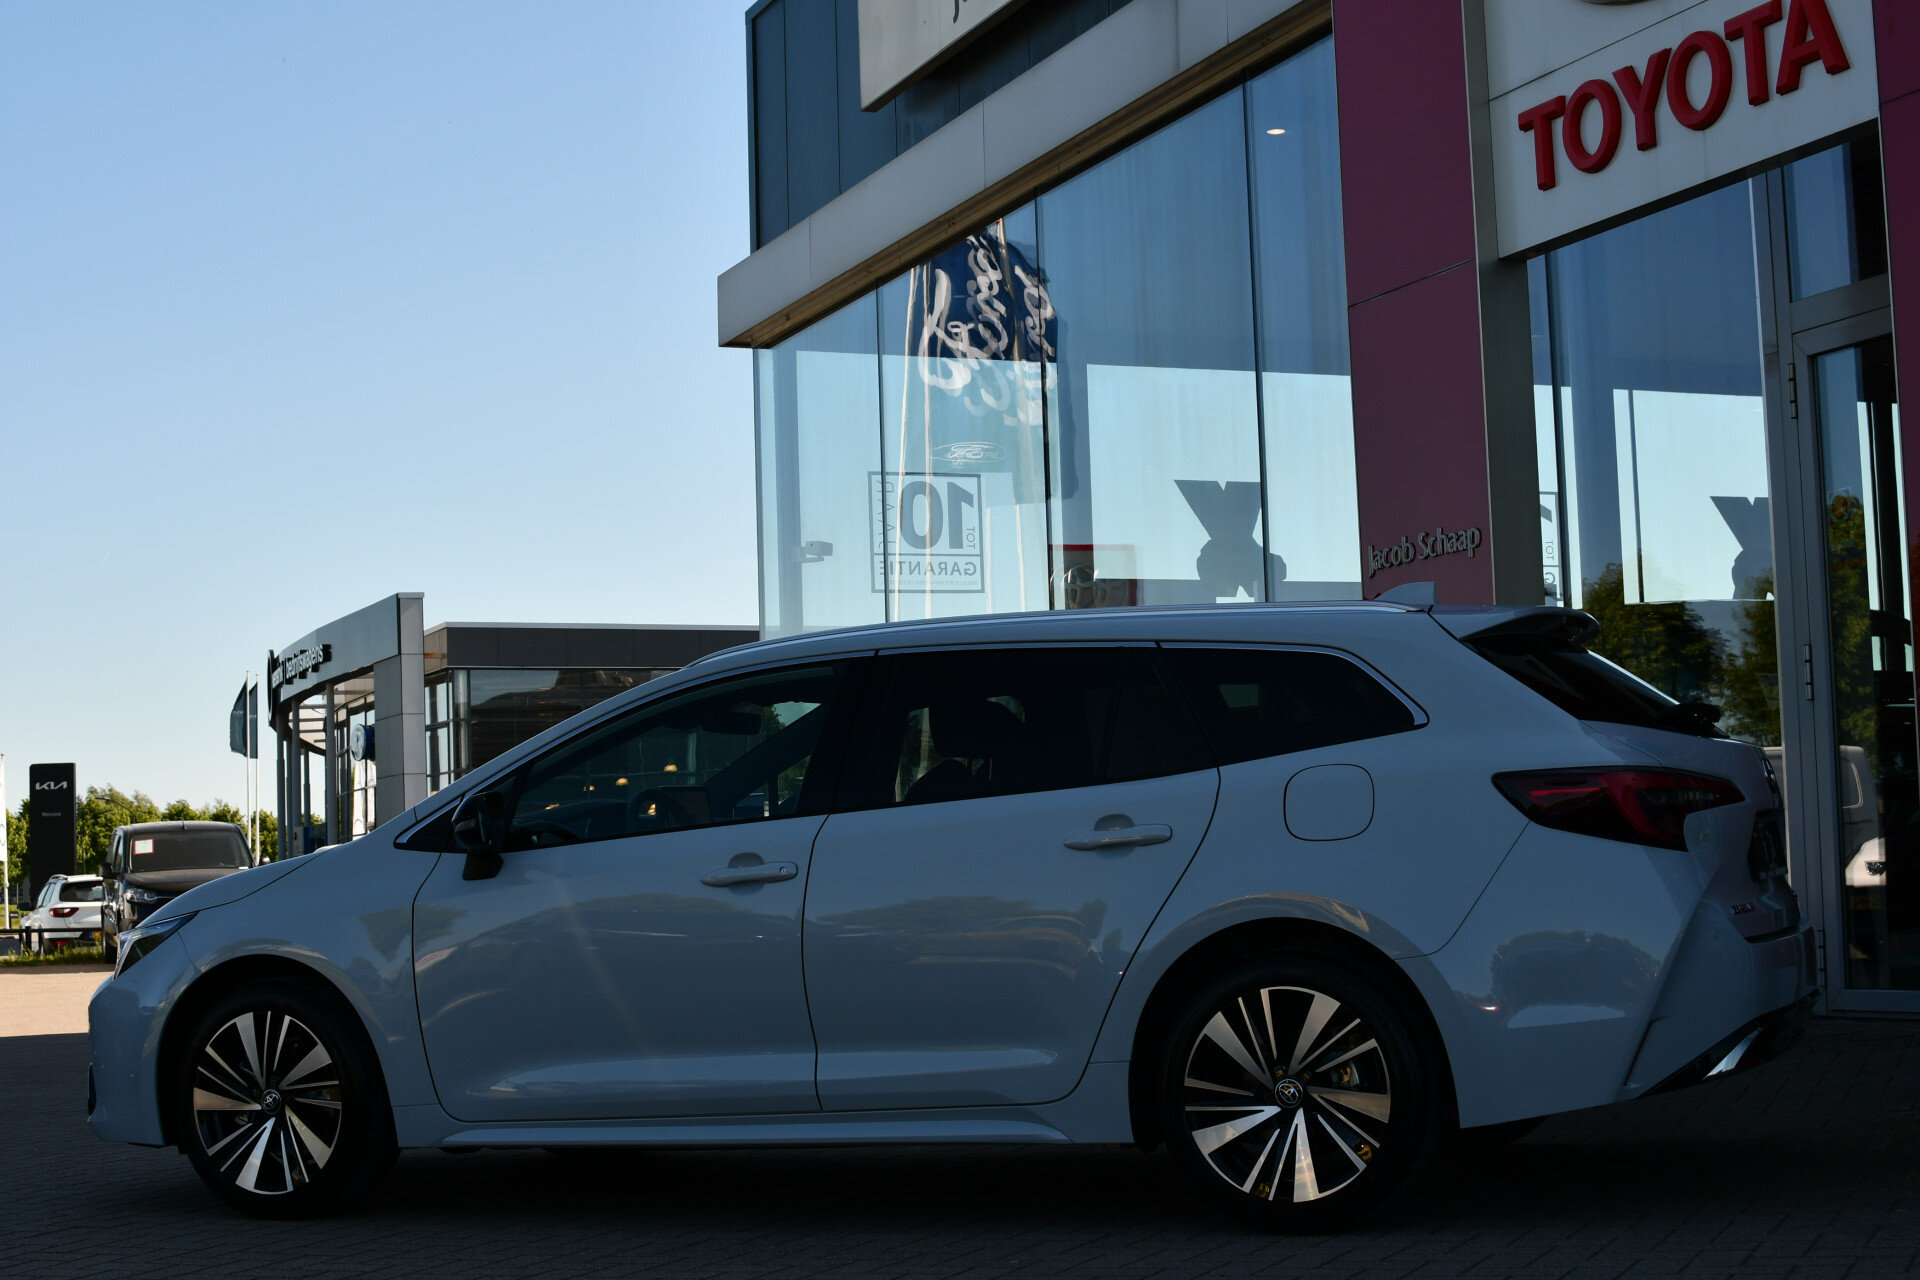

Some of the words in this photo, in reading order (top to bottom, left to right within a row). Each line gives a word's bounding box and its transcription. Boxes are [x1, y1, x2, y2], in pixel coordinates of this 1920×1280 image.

[1517, 0, 1850, 191] TOYOTA
[1368, 536, 1416, 578] Jacob
[1418, 528, 1482, 559] Schaap
[35, 781, 67, 790] KIA
